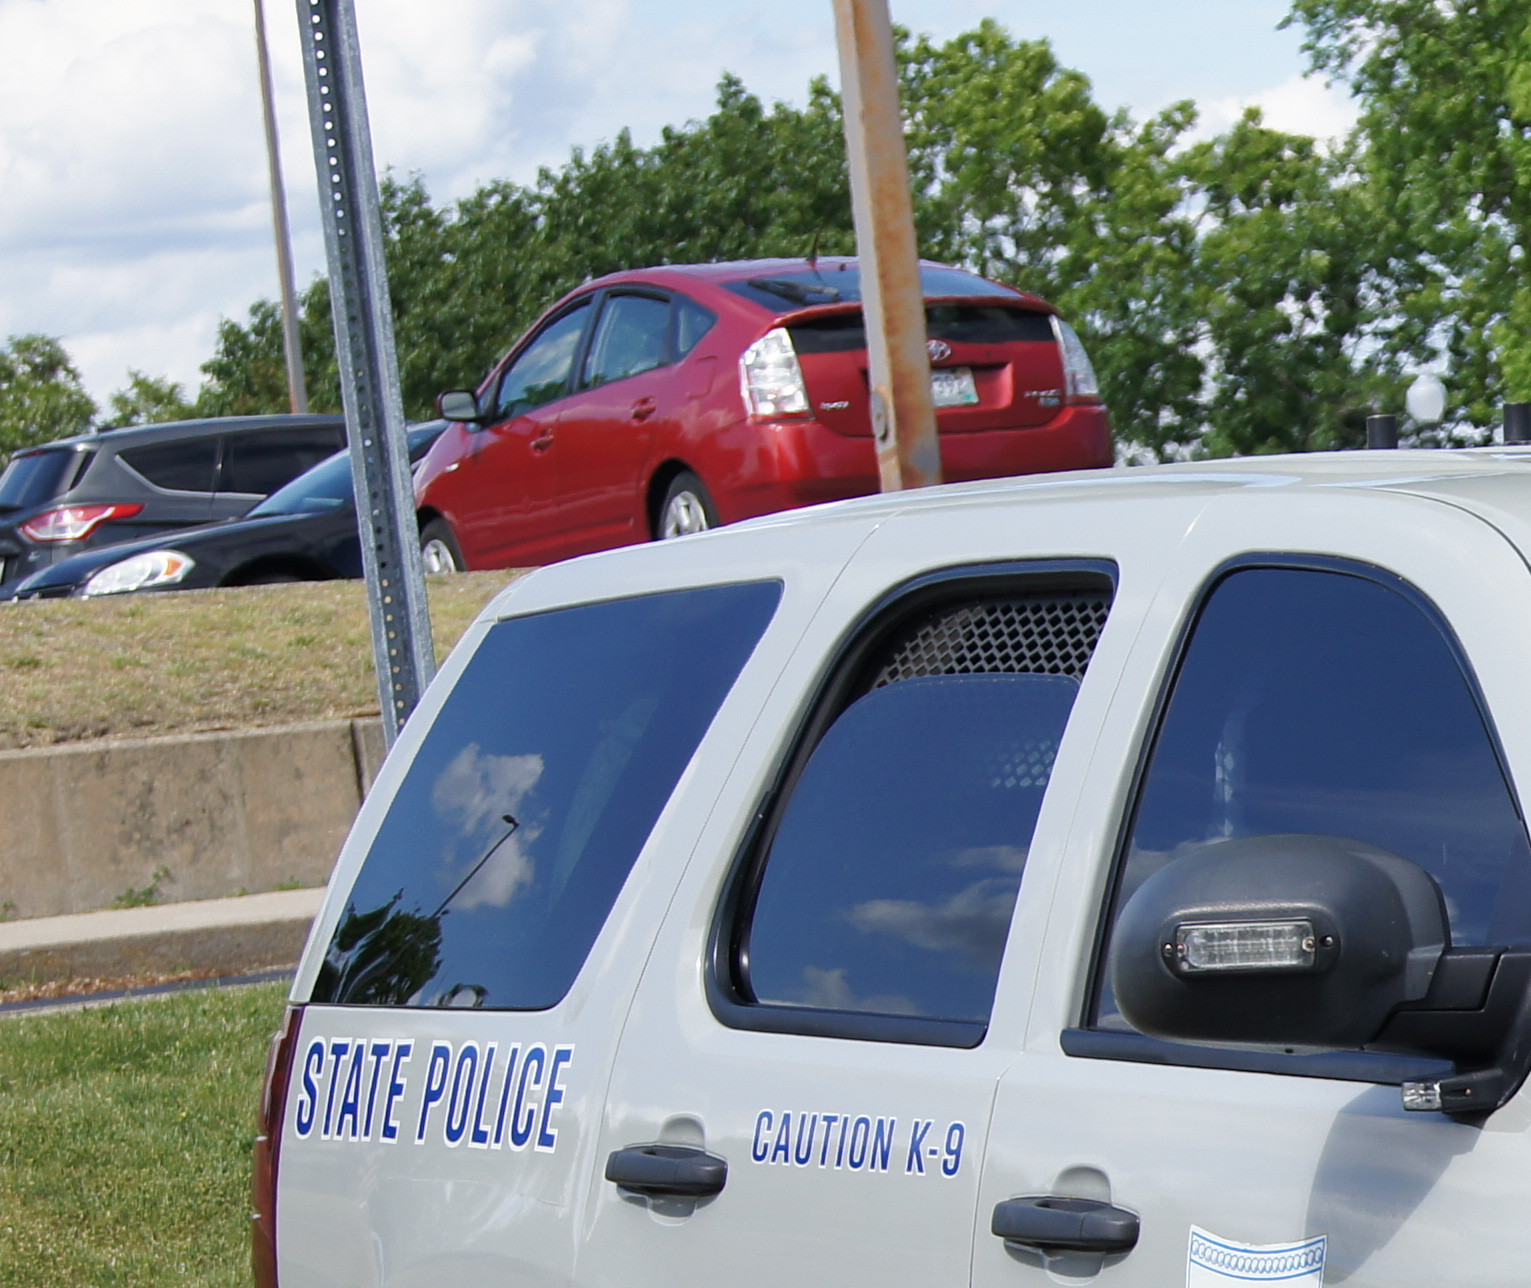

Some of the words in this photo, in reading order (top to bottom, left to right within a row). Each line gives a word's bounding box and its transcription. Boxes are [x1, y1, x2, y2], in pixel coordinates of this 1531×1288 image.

[295, 1036, 415, 1144] STATE
[414, 1040, 576, 1153] POLICE
[751, 1109, 897, 1174] CAUTION
[904, 1118, 967, 1179] K-9
